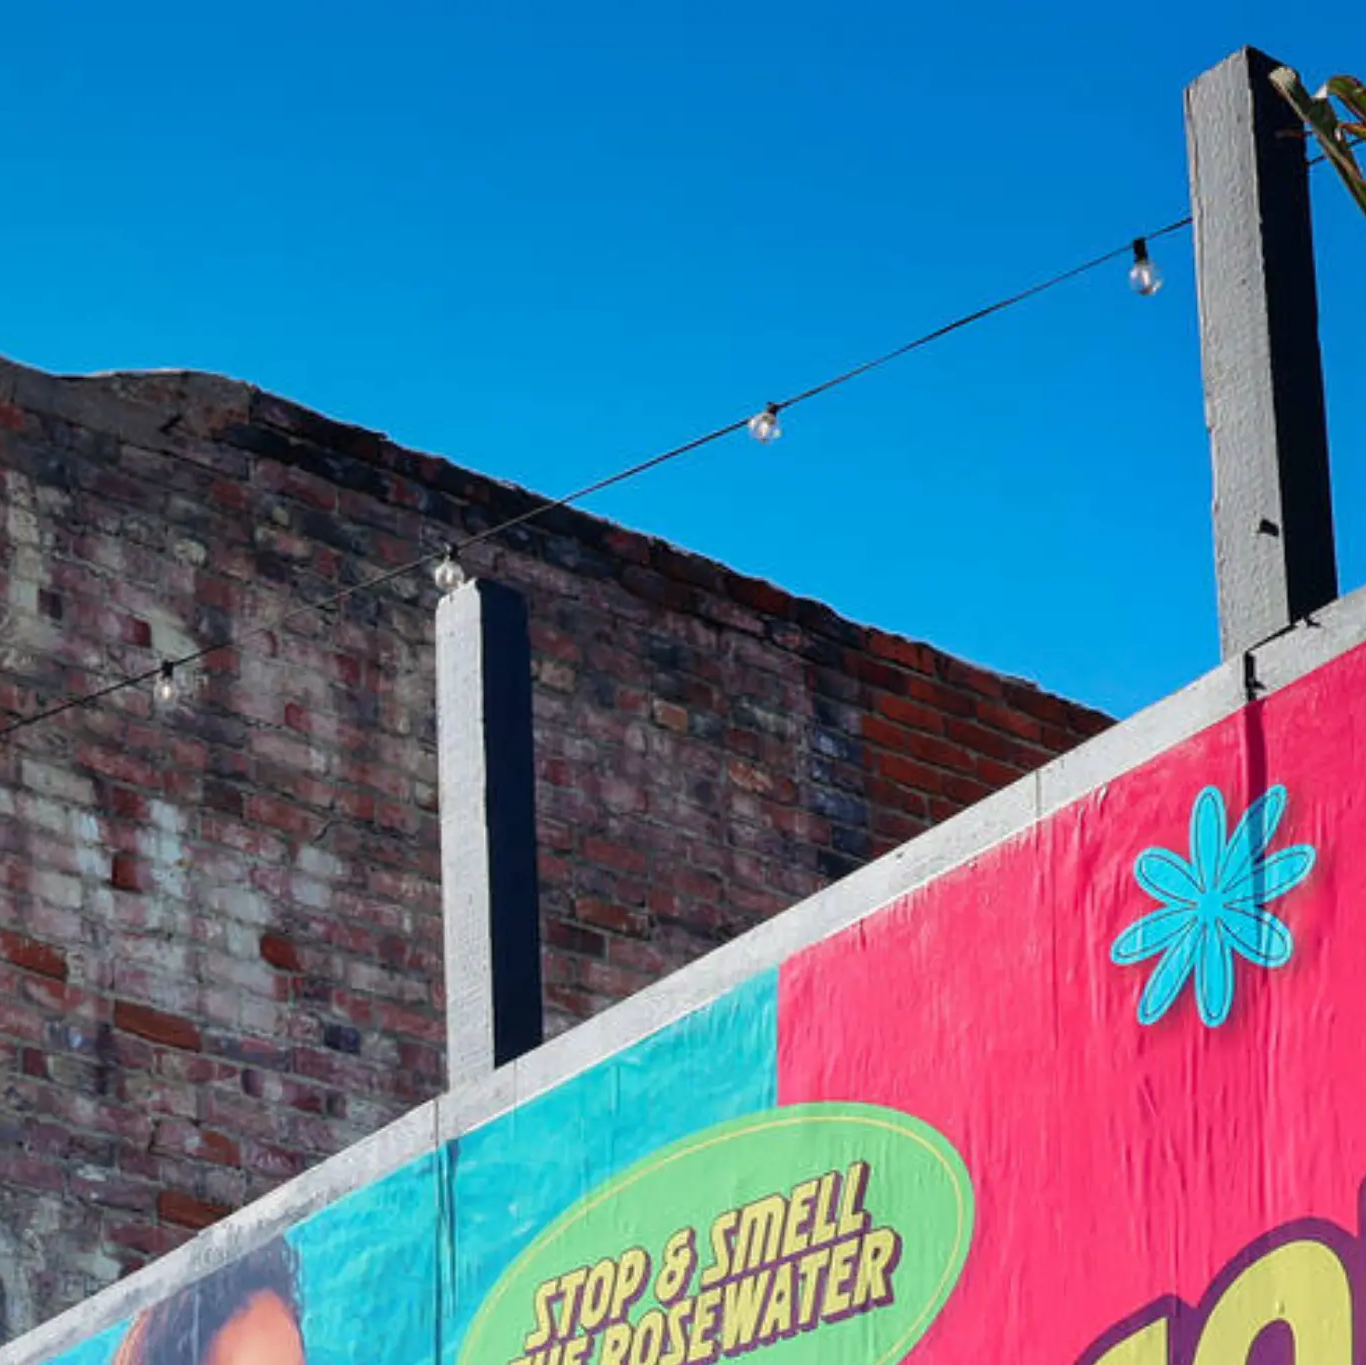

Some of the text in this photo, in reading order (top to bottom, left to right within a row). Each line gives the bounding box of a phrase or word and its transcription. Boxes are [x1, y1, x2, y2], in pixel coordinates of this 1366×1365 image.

[527, 1162, 869, 1352] STOP & SMELL
